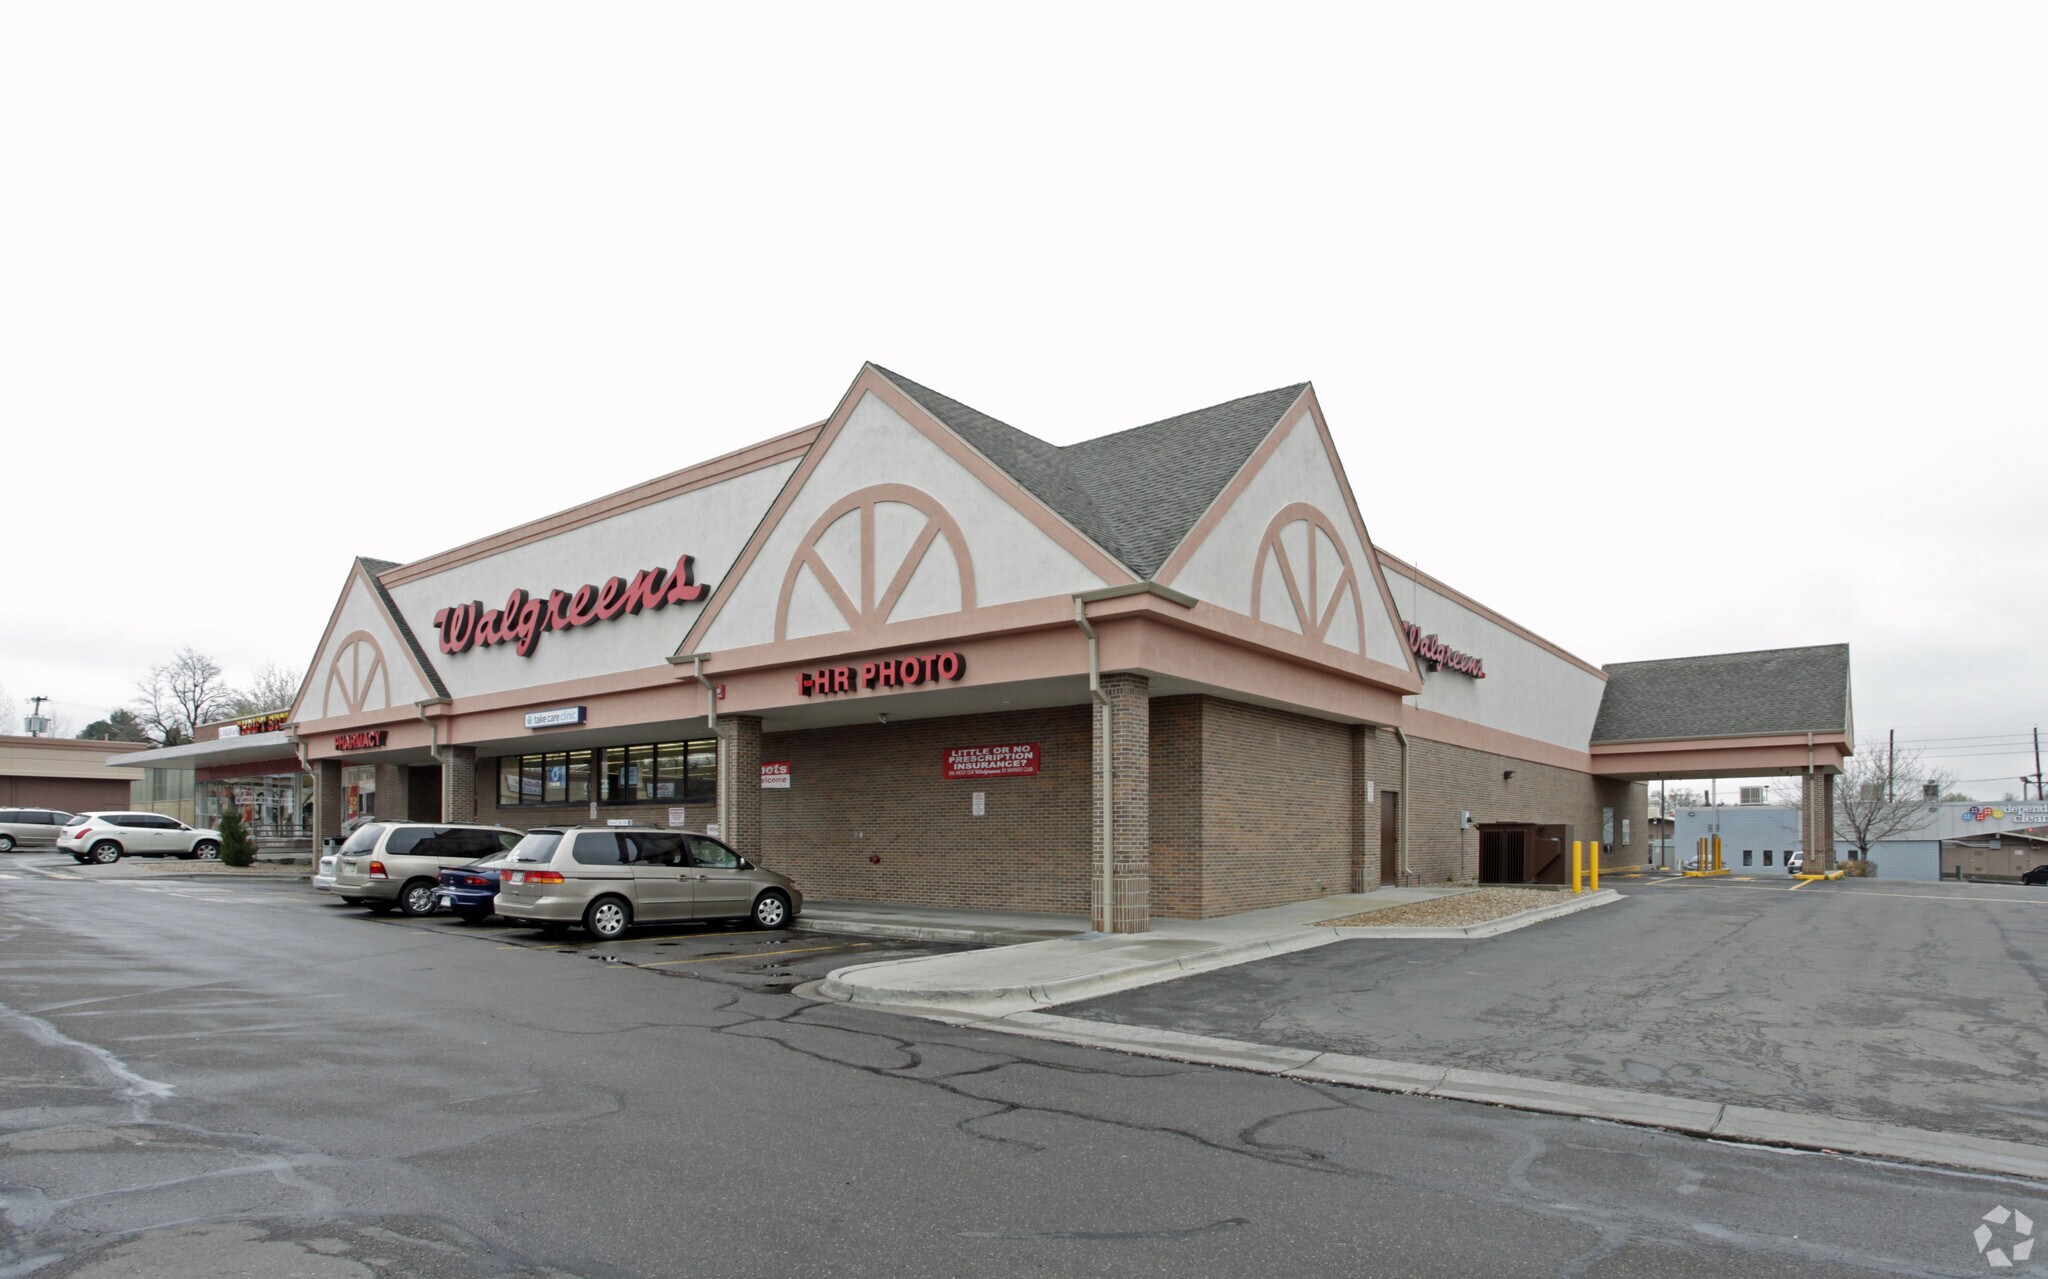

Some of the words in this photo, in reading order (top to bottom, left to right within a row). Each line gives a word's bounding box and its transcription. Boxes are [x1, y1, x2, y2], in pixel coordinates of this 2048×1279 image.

[433, 554, 709, 657] Walgreens
[1403, 620, 1486, 679] Walgreens
[862, 652, 966, 689] PHOTO
[534, 713, 546, 724] take
[547, 713, 560, 722] care
[561, 709, 577, 721] clinic
[335, 731, 384, 750] PHARMACY
[949, 752, 1033, 764] PRESCRIPTION
[952, 748, 990, 757] LITTLE
[993, 746, 1010, 754] OR
[1013, 745, 1031, 753] NO
[953, 759, 1027, 770] INSURANCE?
